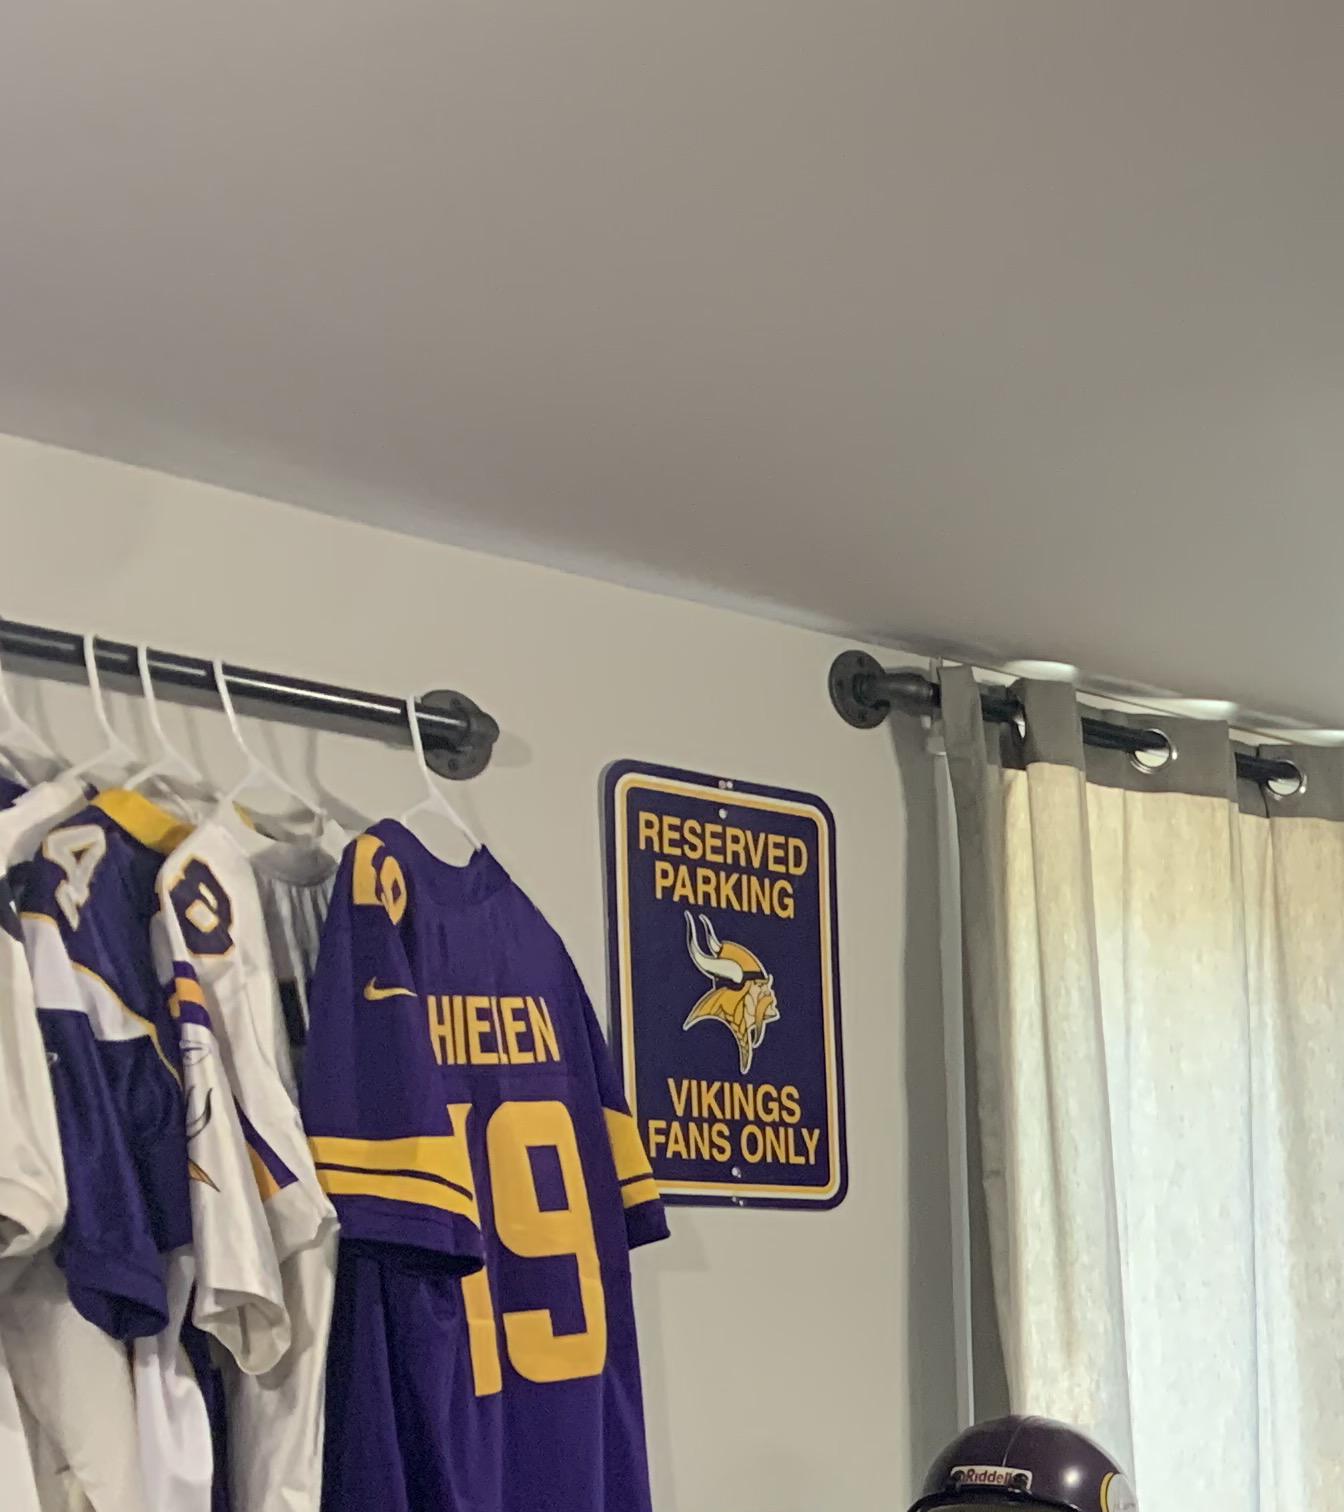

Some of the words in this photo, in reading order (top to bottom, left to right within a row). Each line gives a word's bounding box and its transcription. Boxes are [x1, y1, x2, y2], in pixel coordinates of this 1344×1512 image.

[638, 811, 809, 876] RESERVED
[655, 860, 795, 919] PARKING
[427, 995, 561, 1066] HIELEN
[667, 1077, 802, 1125] VIKINGS
[647, 1119, 733, 1162] FANS
[741, 1124, 822, 1166] ONLY
[446, 1101, 608, 1397] 19
